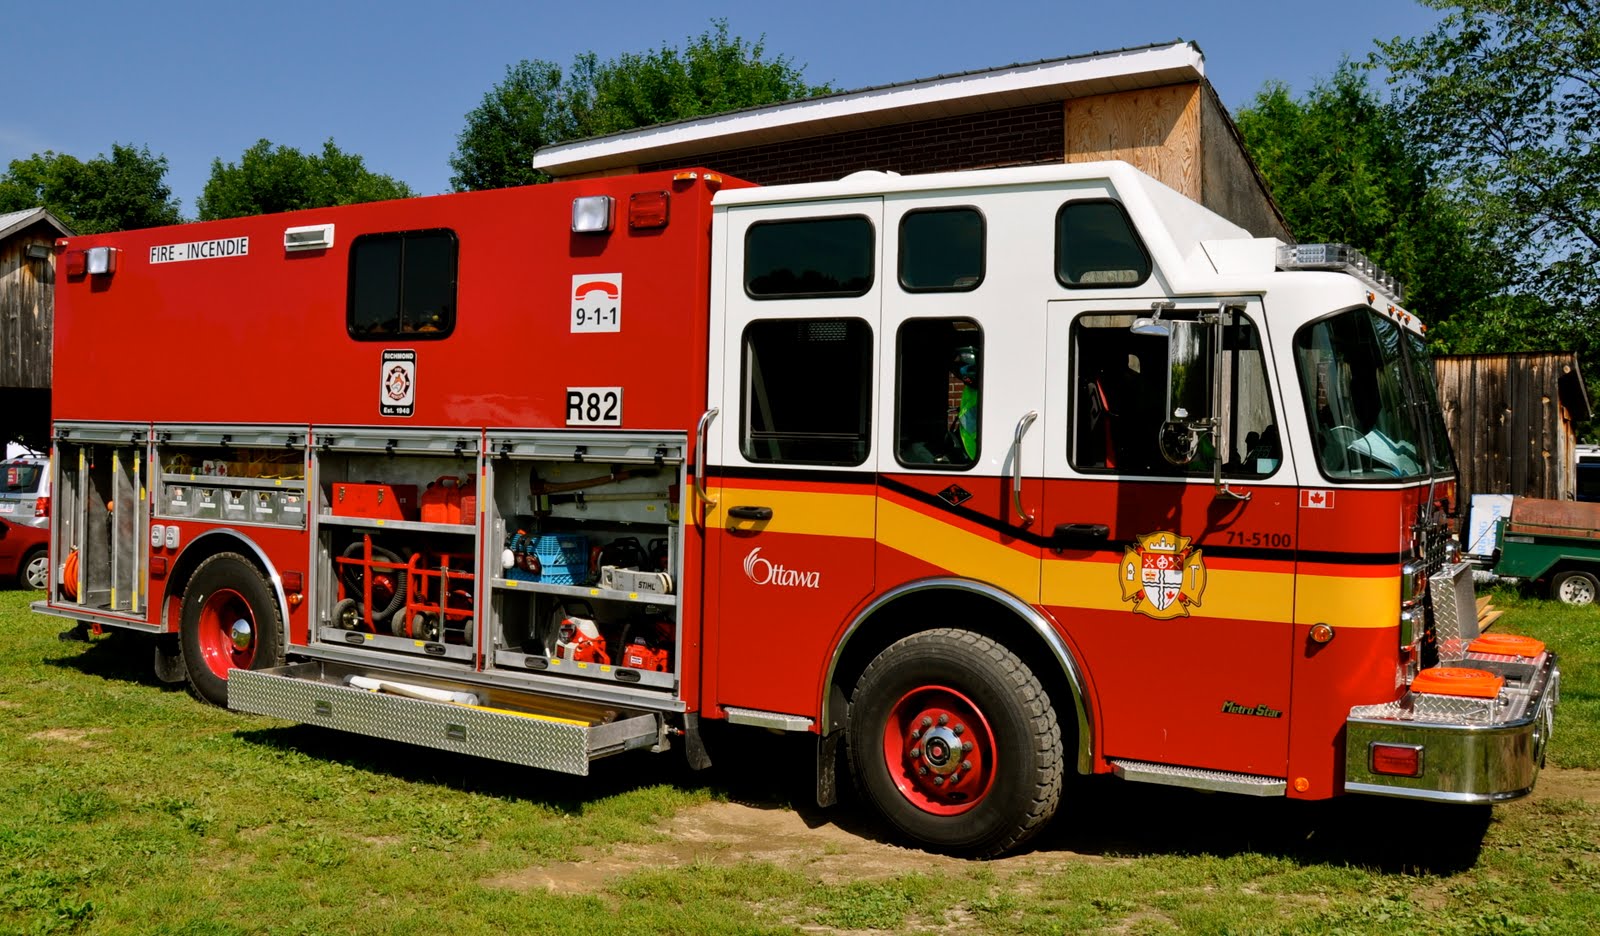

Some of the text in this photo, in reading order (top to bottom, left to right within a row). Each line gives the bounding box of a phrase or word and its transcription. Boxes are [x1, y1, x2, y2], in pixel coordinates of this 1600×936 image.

[151, 246, 175, 262] FIRE
[187, 238, 247, 259] INCENDIE
[575, 306, 617, 326] 9-1-1
[566, 390, 618, 422] R82
[1226, 531, 1291, 547] 71-5100
[743, 546, 820, 588] Ottawa
[638, 581, 656, 591] STIHL
[1221, 700, 1280, 718] Metro Star
